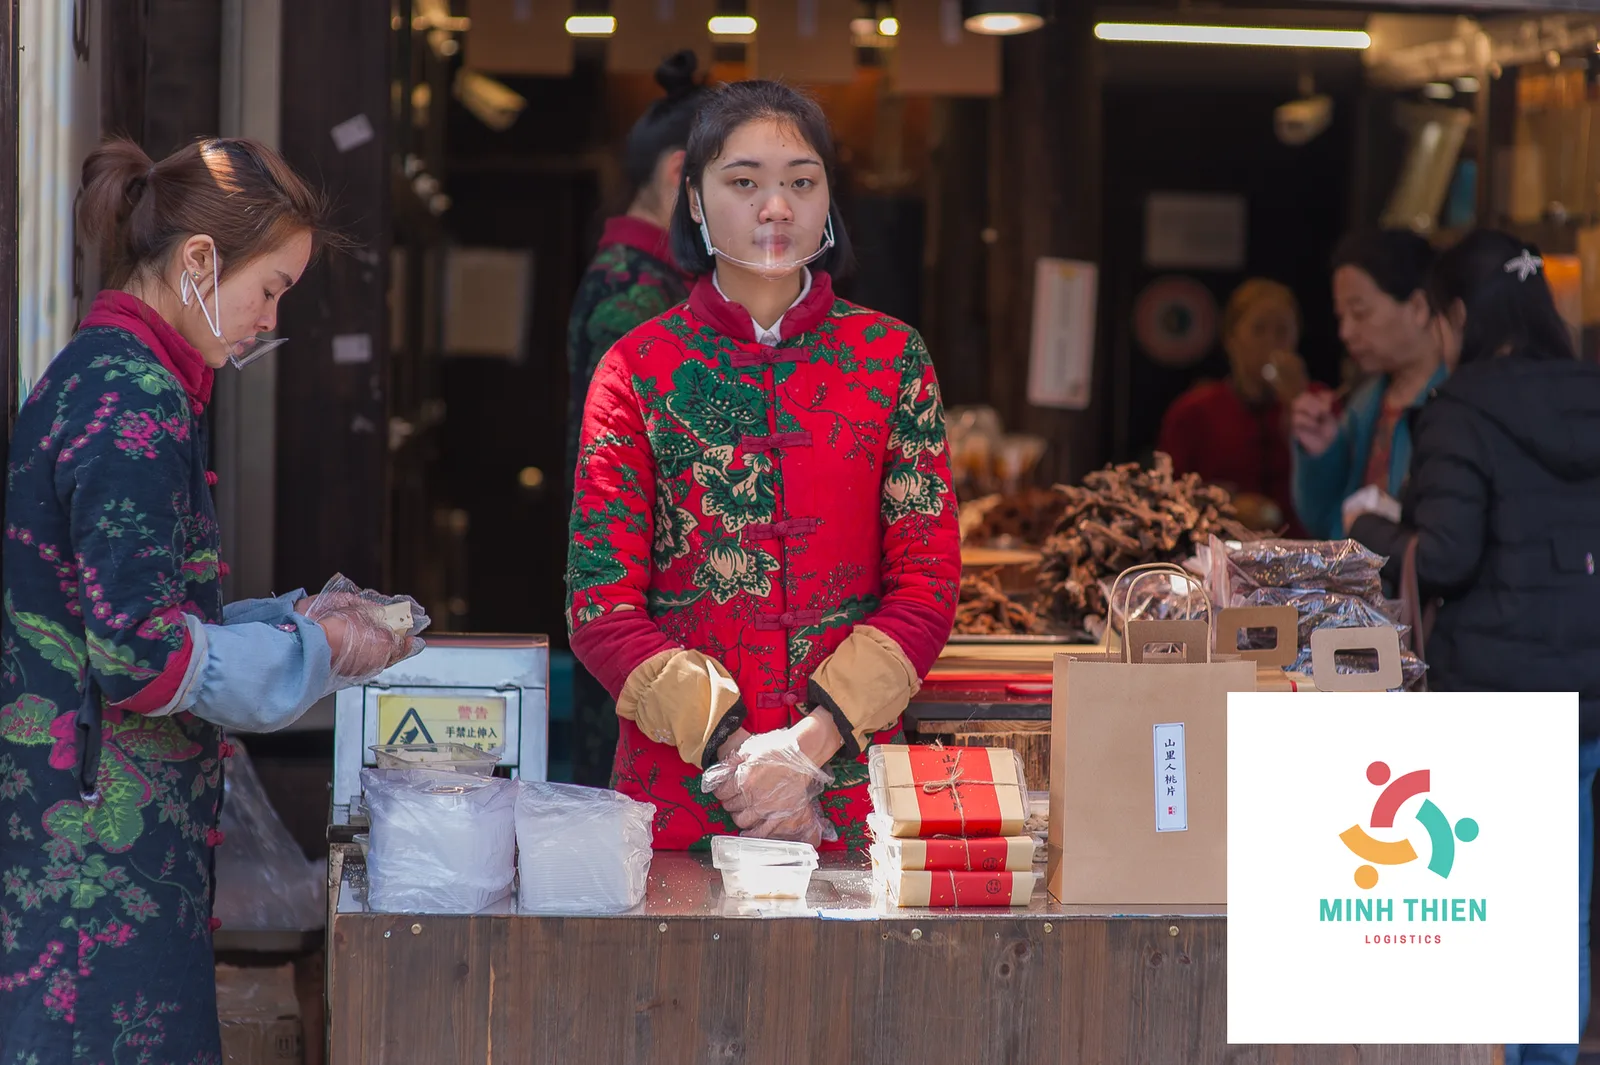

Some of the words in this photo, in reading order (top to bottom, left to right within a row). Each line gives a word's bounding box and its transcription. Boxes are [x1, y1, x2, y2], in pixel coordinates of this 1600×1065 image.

[458, 705, 488, 720] 警告
[445, 726, 497, 738] 手禁止伸入
[1164, 738, 1177, 797] 山里人桃片
